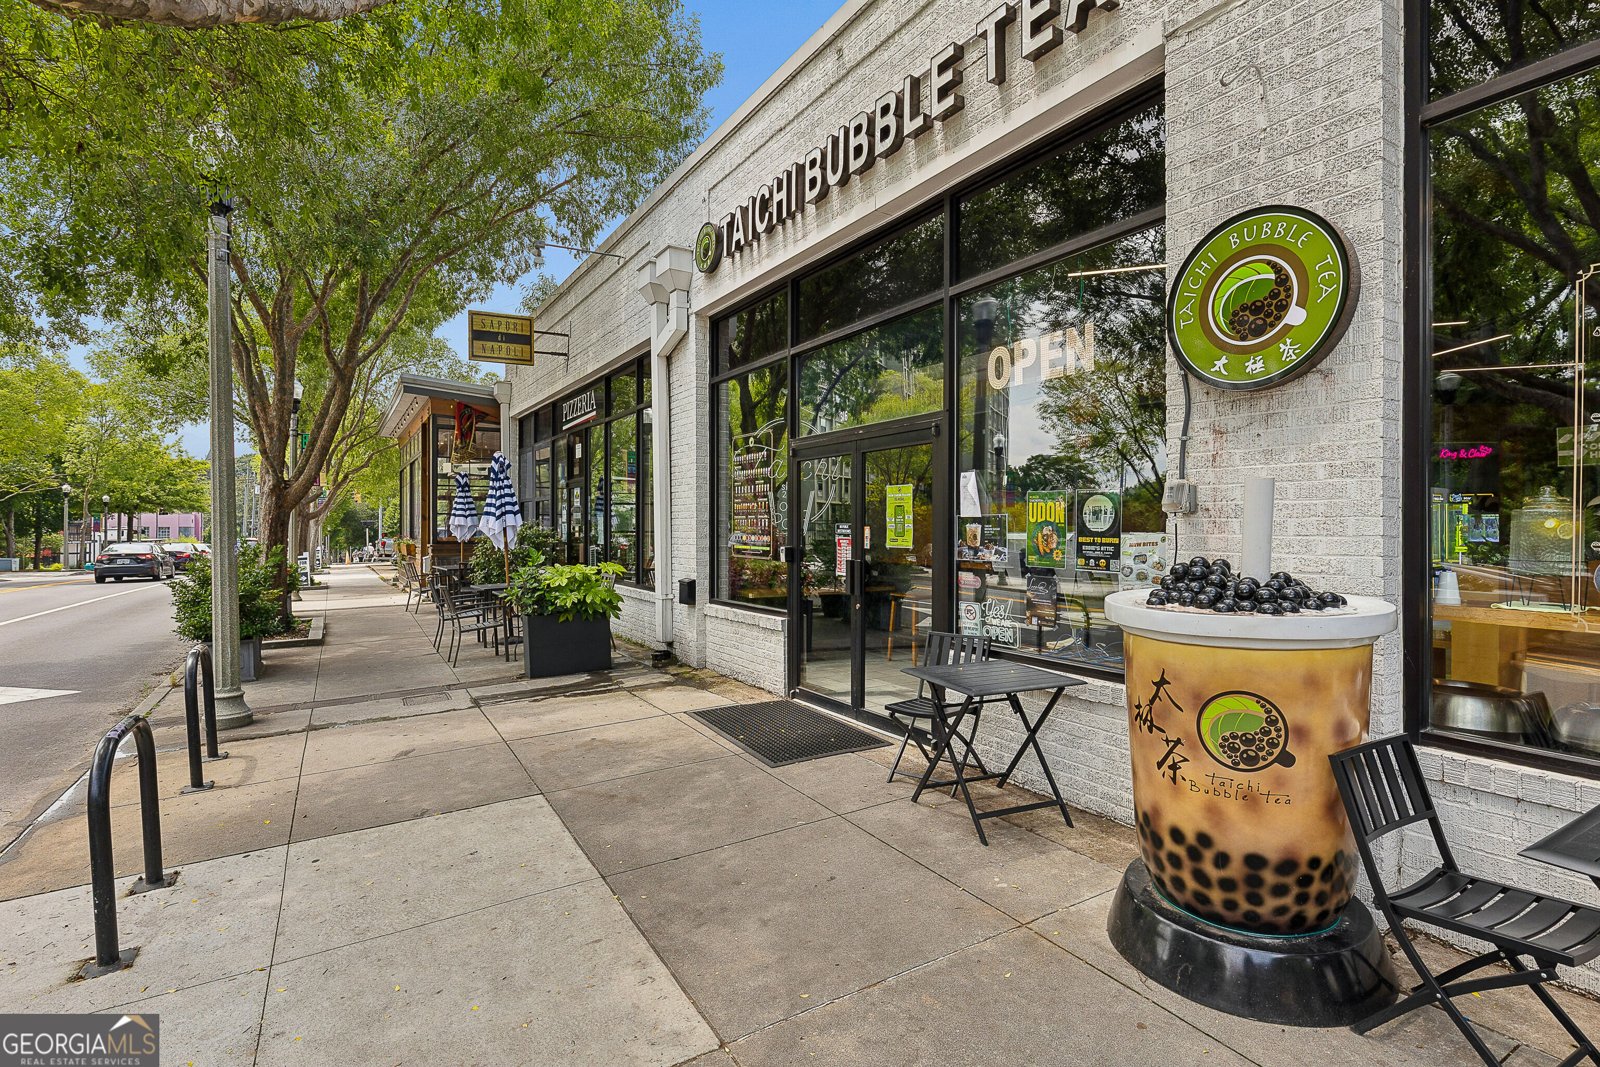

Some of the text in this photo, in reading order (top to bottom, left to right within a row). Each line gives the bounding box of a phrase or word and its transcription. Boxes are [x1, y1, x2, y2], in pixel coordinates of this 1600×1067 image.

[720, 162, 802, 259] TAICHI
[805, 42, 965, 205] BUBBLE
[1179, 221, 1338, 330] TAICHI BUBBLE TEA
[480, 318, 525, 334] SAPORI
[481, 343, 525, 358] NAPOLI
[987, 322, 1095, 390] OPEN
[562, 389, 597, 422] PIZZERIA
[1028, 501, 1065, 524] UDON
[982, 625, 1014, 643] OPEN
[1189, 779, 1292, 805] Bubble tea
[1205, 772, 1261, 793] taichi
